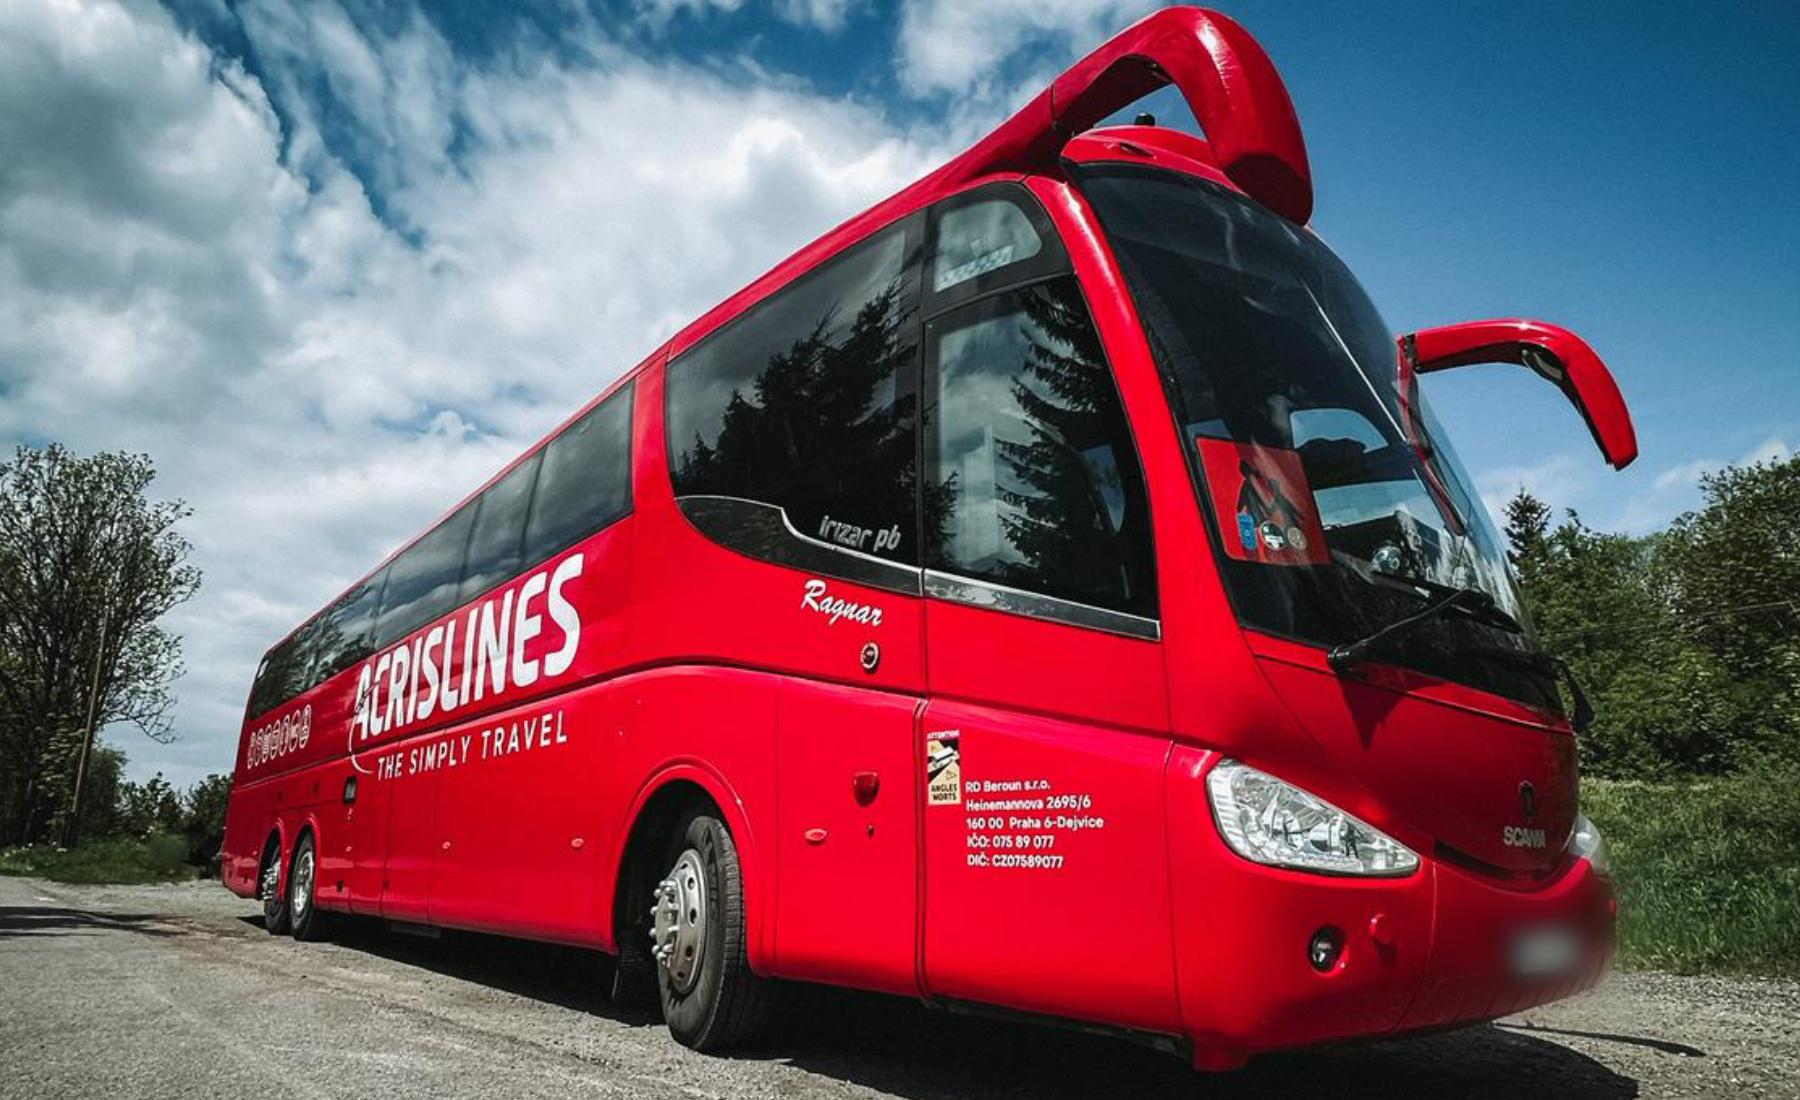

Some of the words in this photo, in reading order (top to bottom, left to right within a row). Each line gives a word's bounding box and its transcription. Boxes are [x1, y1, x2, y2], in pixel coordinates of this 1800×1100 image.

[818, 515, 872, 548] irizar
[874, 524, 903, 552] pb
[801, 579, 883, 627] Ragnar
[353, 553, 585, 740] ACRISLINES
[378, 752, 404, 781] THE
[409, 735, 471, 775] SIMPLY
[481, 710, 567, 759] TRAVEL
[931, 783, 957, 793] ANGLES
[965, 781, 981, 792] RD
[983, 780, 1021, 792] Beroun
[1024, 780, 1051, 790] s.r.o.
[932, 793, 958, 801] MORTS
[966, 798, 1044, 811] Heinemannova
[1046, 794, 1092, 811] 2695/6
[966, 817, 986, 829] 160
[988, 817, 1004, 829] 00
[1009, 815, 1042, 829] Praha
[966, 832, 990, 848] IČO:
[993, 834, 1013, 848] 075
[1015, 834, 1031, 848] 89
[1033, 834, 1055, 848] 077
[1503, 826, 1546, 848] SCANIA
[992, 854, 1064, 869] CZ07589077
